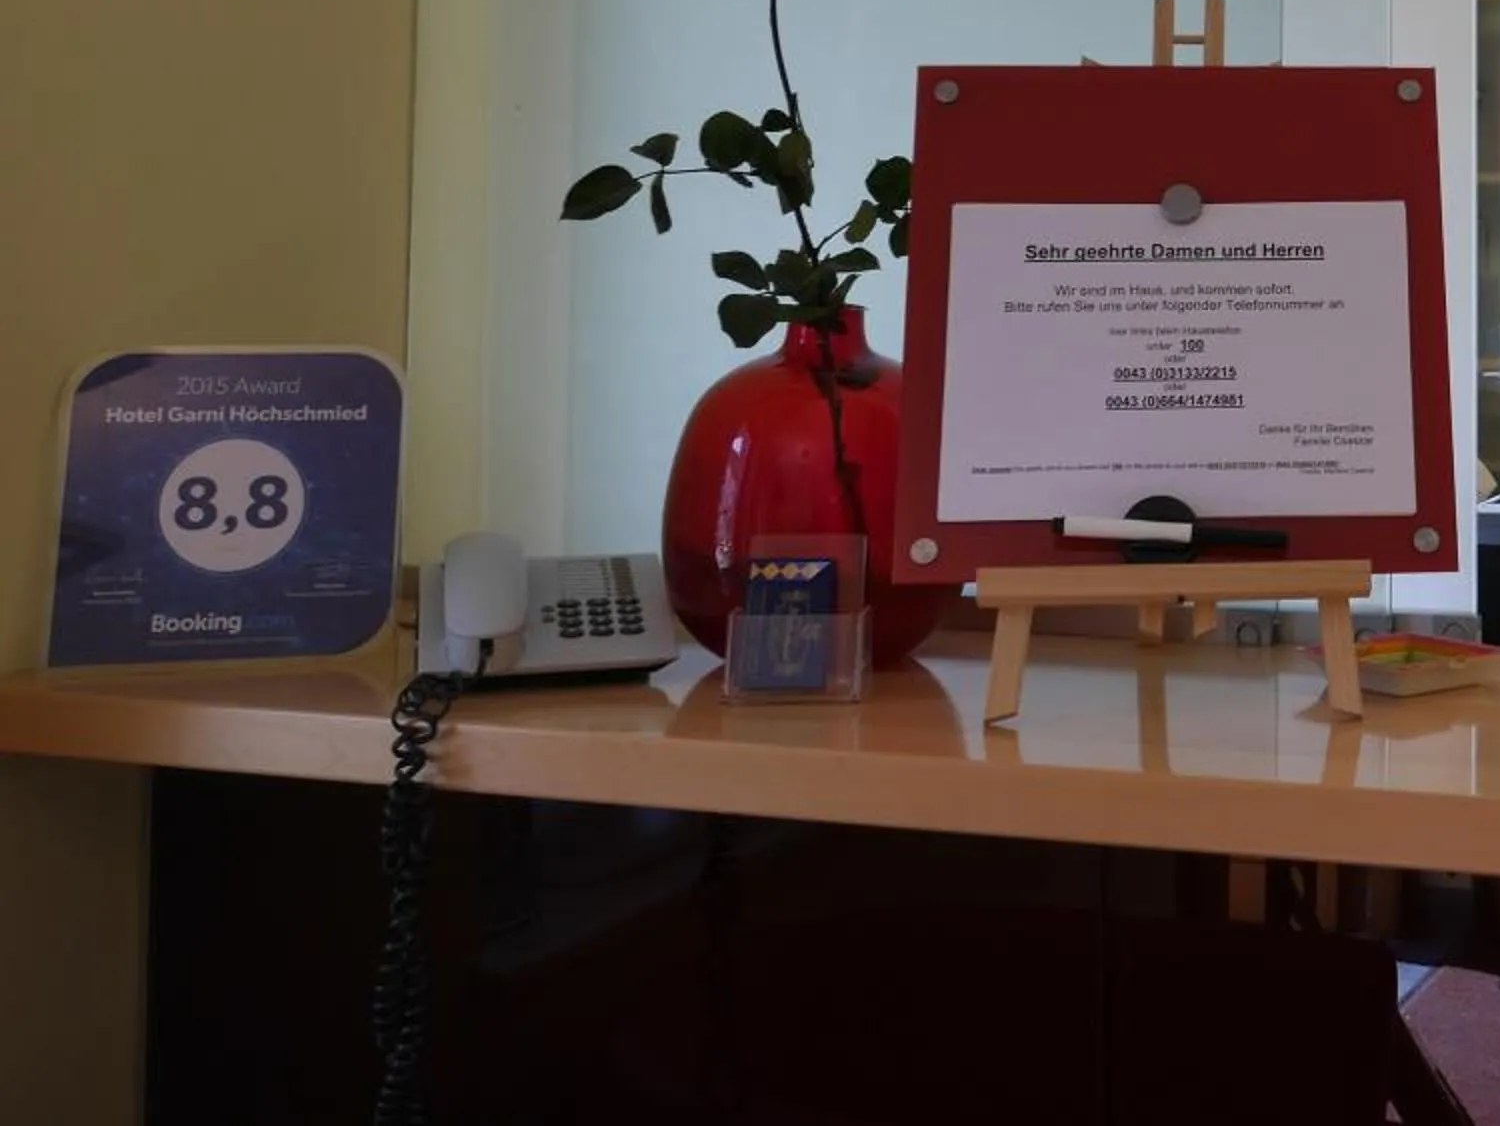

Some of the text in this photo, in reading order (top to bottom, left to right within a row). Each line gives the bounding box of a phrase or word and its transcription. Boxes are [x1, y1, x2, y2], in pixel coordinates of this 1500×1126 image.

[1025, 242, 1325, 262] Sehr geehrte Damen und Herren
[1054, 284, 1076, 297] Wir
[1079, 284, 1107, 297] sind
[1170, 284, 1195, 296] und
[1198, 283, 1252, 296] kommen
[1004, 298, 1345, 314] Bitte rufen Sie uns unter folgender Telefonnummer an
[1180, 338, 1204, 353] 100
[1113, 366, 1147, 381] 0043
[176, 376, 301, 395] 2015 Award
[1105, 394, 1139, 409] 0043
[105, 402, 368, 424] Hotel Garni Höchschmied
[174, 474, 289, 535] 8,8
